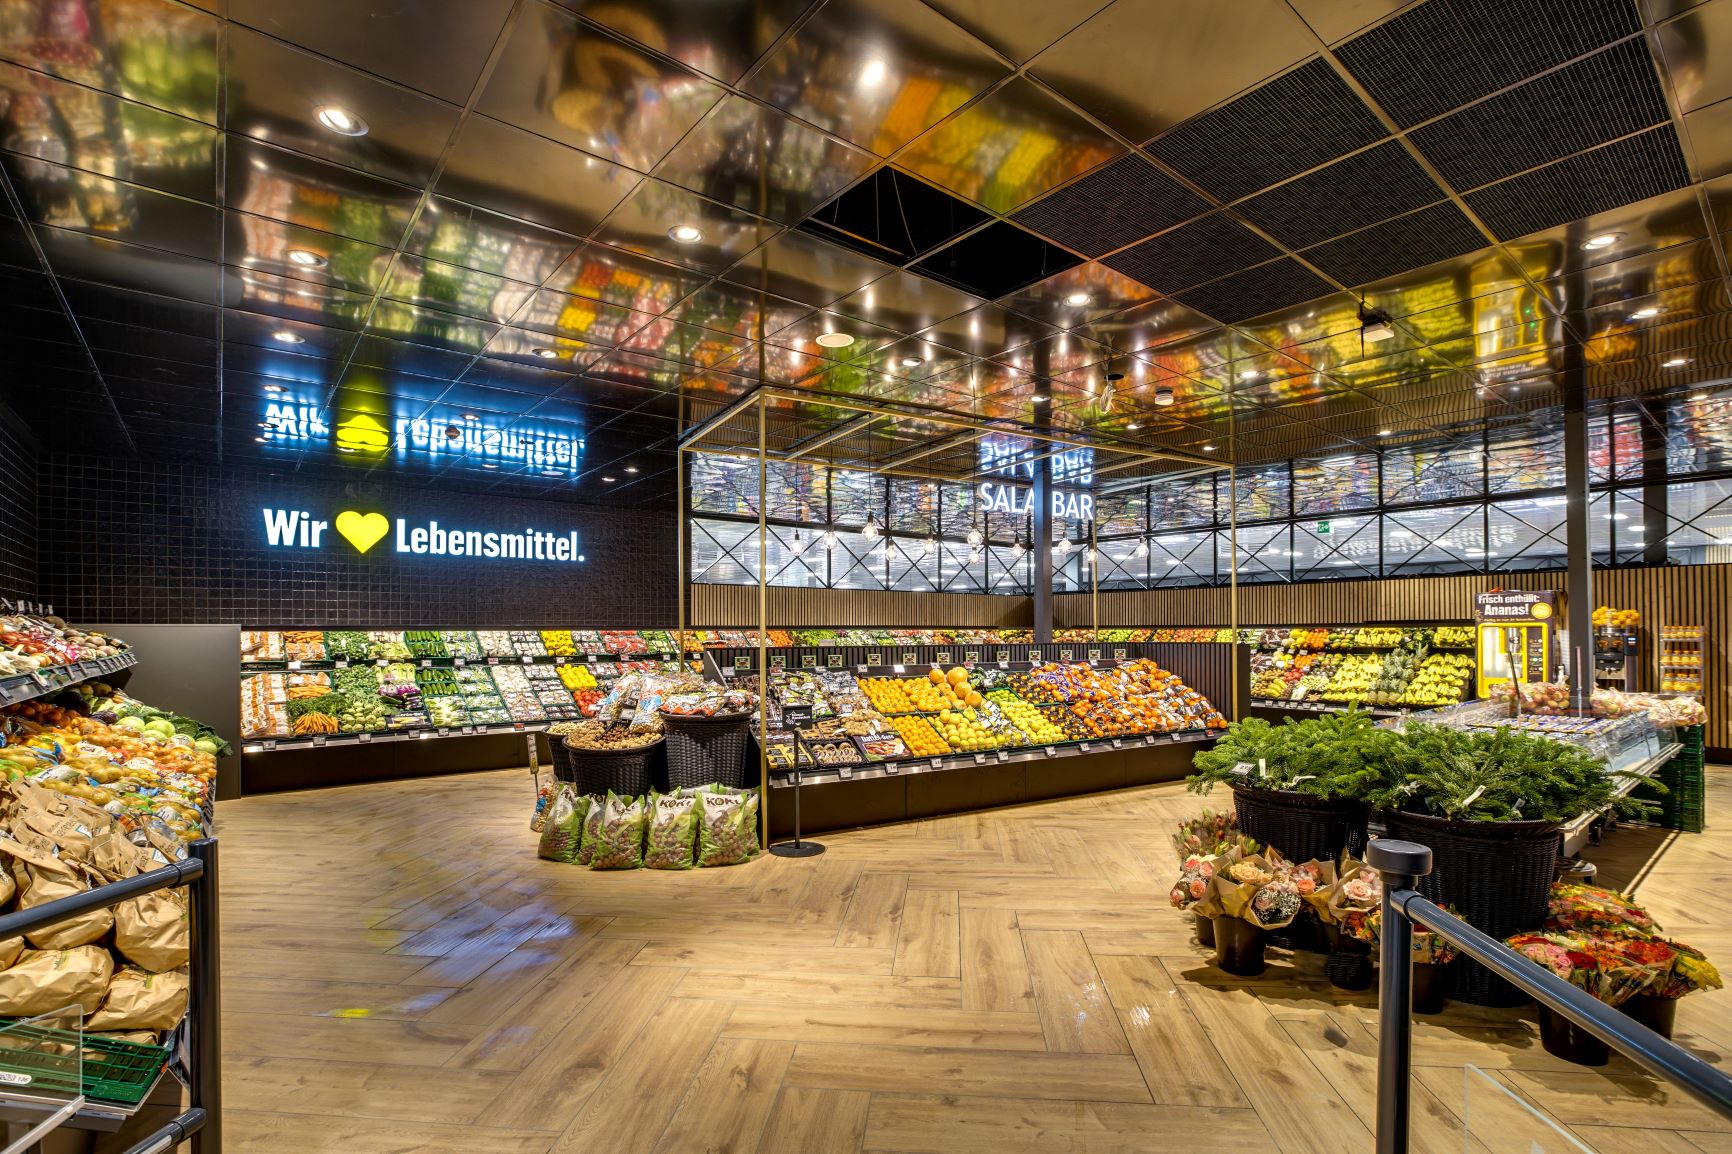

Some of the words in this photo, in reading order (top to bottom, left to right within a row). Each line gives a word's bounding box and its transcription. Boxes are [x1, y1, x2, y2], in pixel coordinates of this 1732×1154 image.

[980, 482, 1035, 513] SALA
[1052, 491, 1094, 520] BAR
[263, 508, 328, 548] Wir
[396, 518, 585, 562] Lebensmittel.
[1478, 594, 1504, 604] Frisch
[1484, 604, 1529, 616] Ananas!
